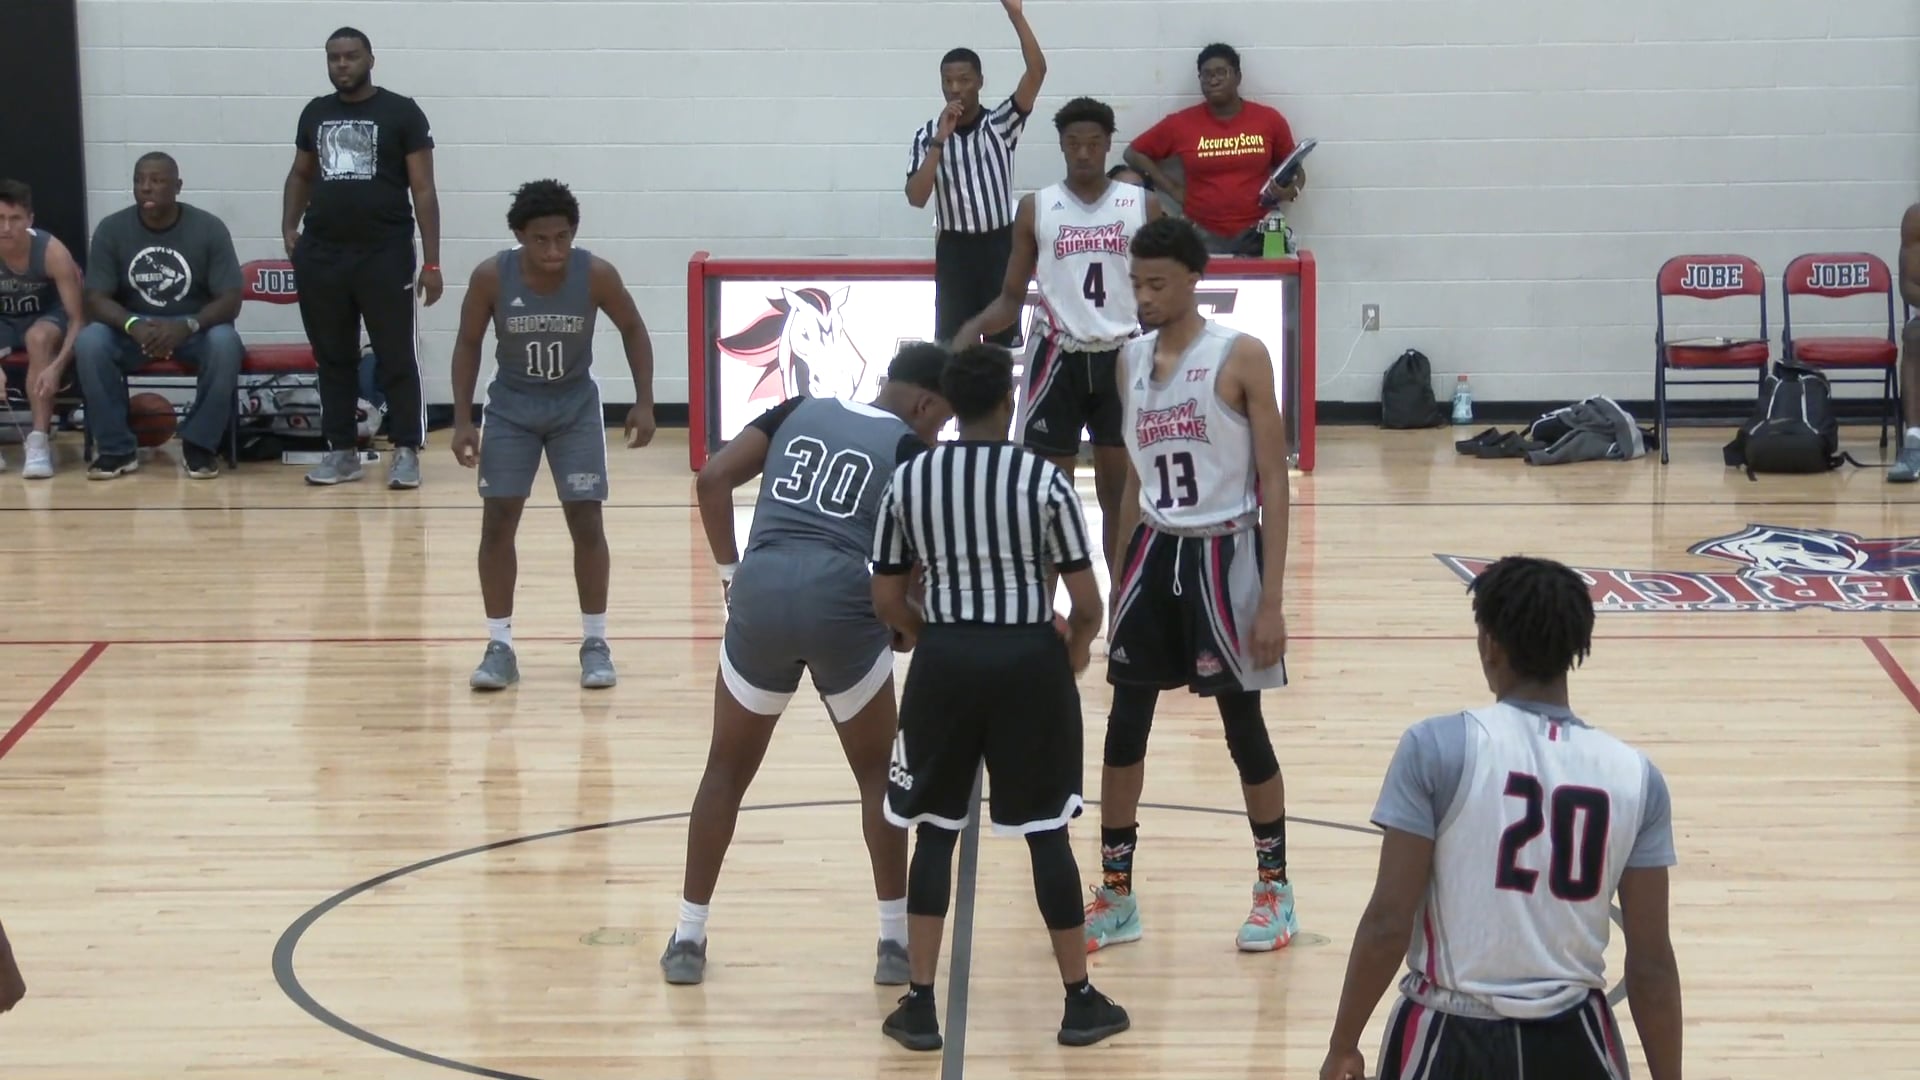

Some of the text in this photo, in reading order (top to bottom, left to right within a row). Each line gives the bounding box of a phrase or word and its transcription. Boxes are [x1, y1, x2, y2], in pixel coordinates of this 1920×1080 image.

[1197, 133, 1264, 151] AccuracyScore
[1059, 222, 1125, 241] DREAM
[1055, 238, 1129, 259] SUPREME
[252, 268, 298, 295] JOB
[1083, 262, 1106, 308] 4
[1681, 263, 1743, 290] JOBE
[1807, 262, 1870, 288] JOBE
[526, 341, 564, 380] 11
[771, 434, 874, 518] 30
[1154, 451, 1199, 509] 13
[1495, 770, 1611, 902] 20
